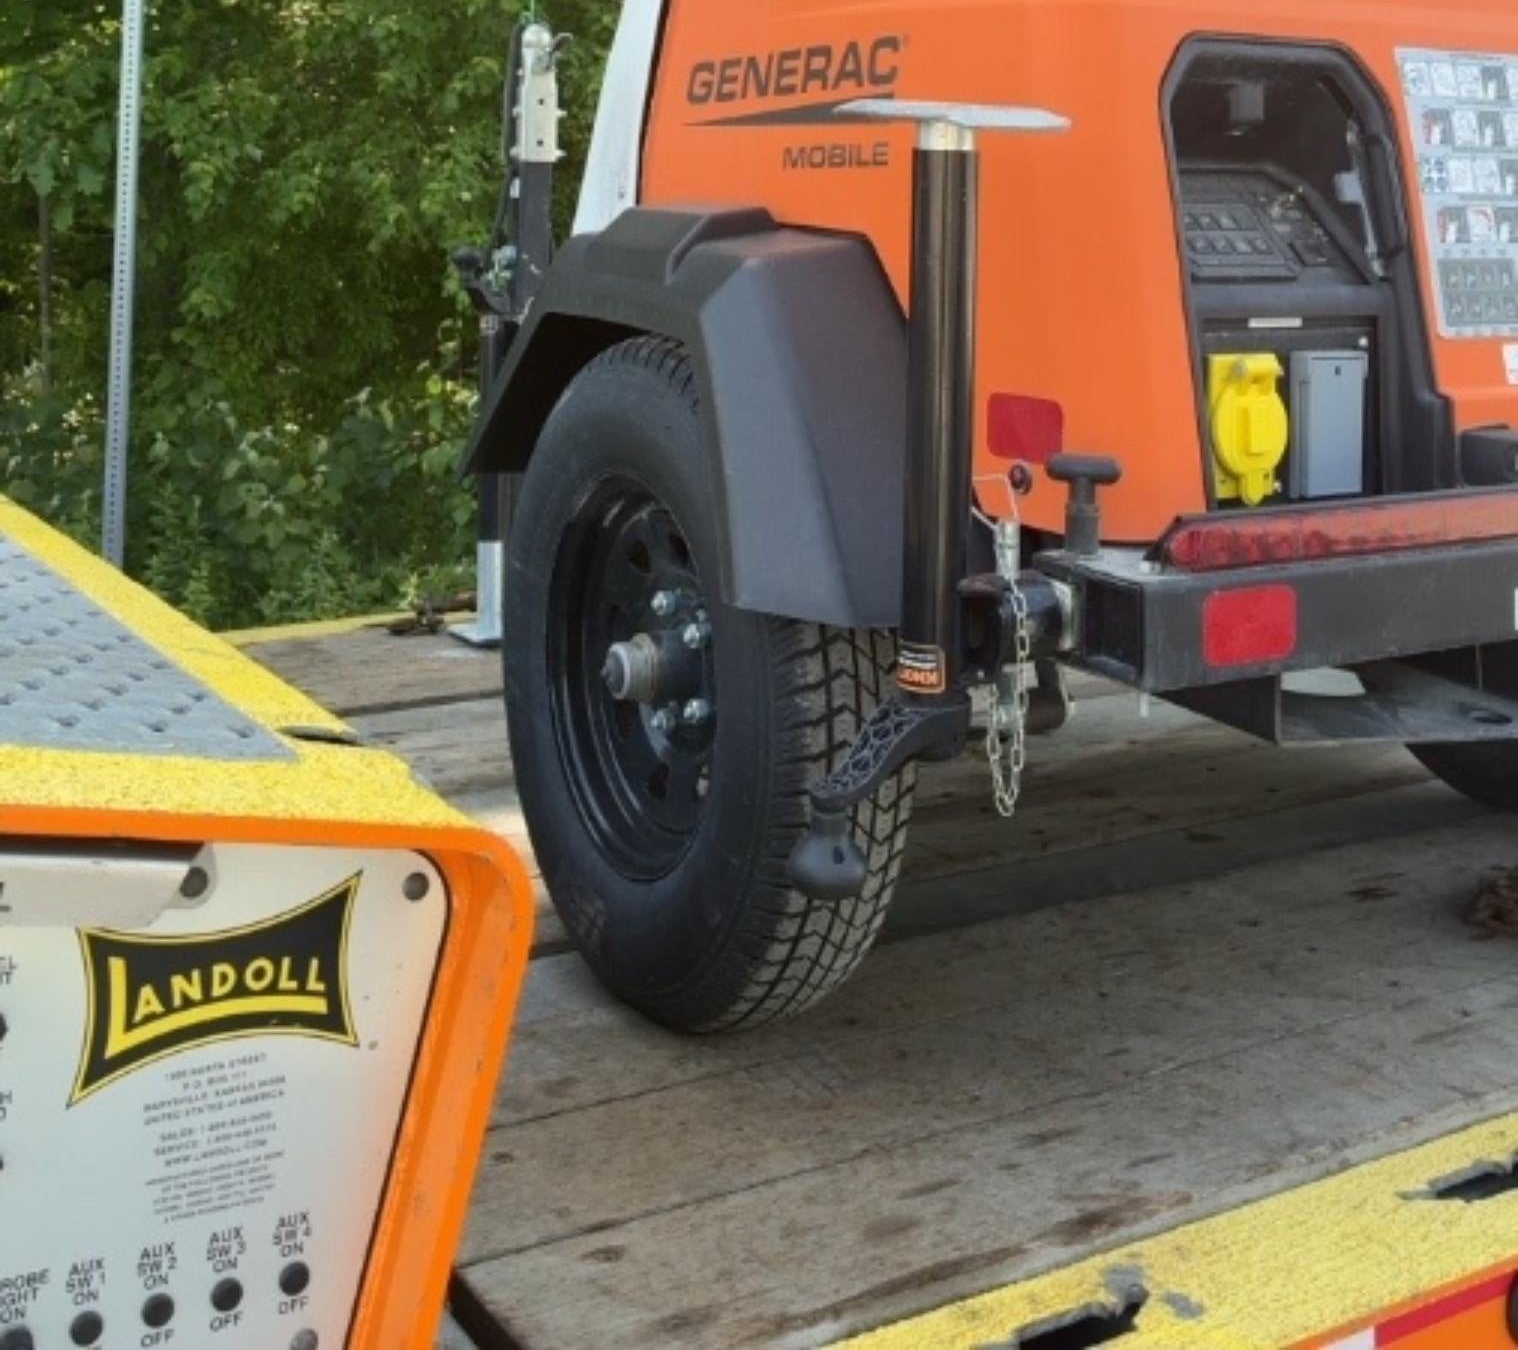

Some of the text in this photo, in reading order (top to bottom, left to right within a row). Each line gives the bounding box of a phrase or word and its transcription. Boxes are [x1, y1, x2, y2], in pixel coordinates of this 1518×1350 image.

[687, 35, 900, 106] GENERAC
[782, 142, 889, 171] MOBILE
[104, 956, 328, 1060] LANDOLL
[277, 1211, 310, 1228] AUX
[210, 1226, 243, 1244] AUX
[140, 1242, 175, 1260] AUX
[207, 1240, 247, 1261] SW 3
[280, 1242, 304, 1258] ON
[69, 1257, 105, 1276] AUX
[137, 1256, 178, 1278] SW 2
[213, 1257, 238, 1273] ON
[65, 1274, 94, 1293] SW
[143, 1273, 169, 1291] ON
[72, 1288, 99, 1305] ON
[278, 1295, 309, 1315] OFF
[209, 1310, 243, 1332] OFF
[140, 1329, 175, 1348] OFF
